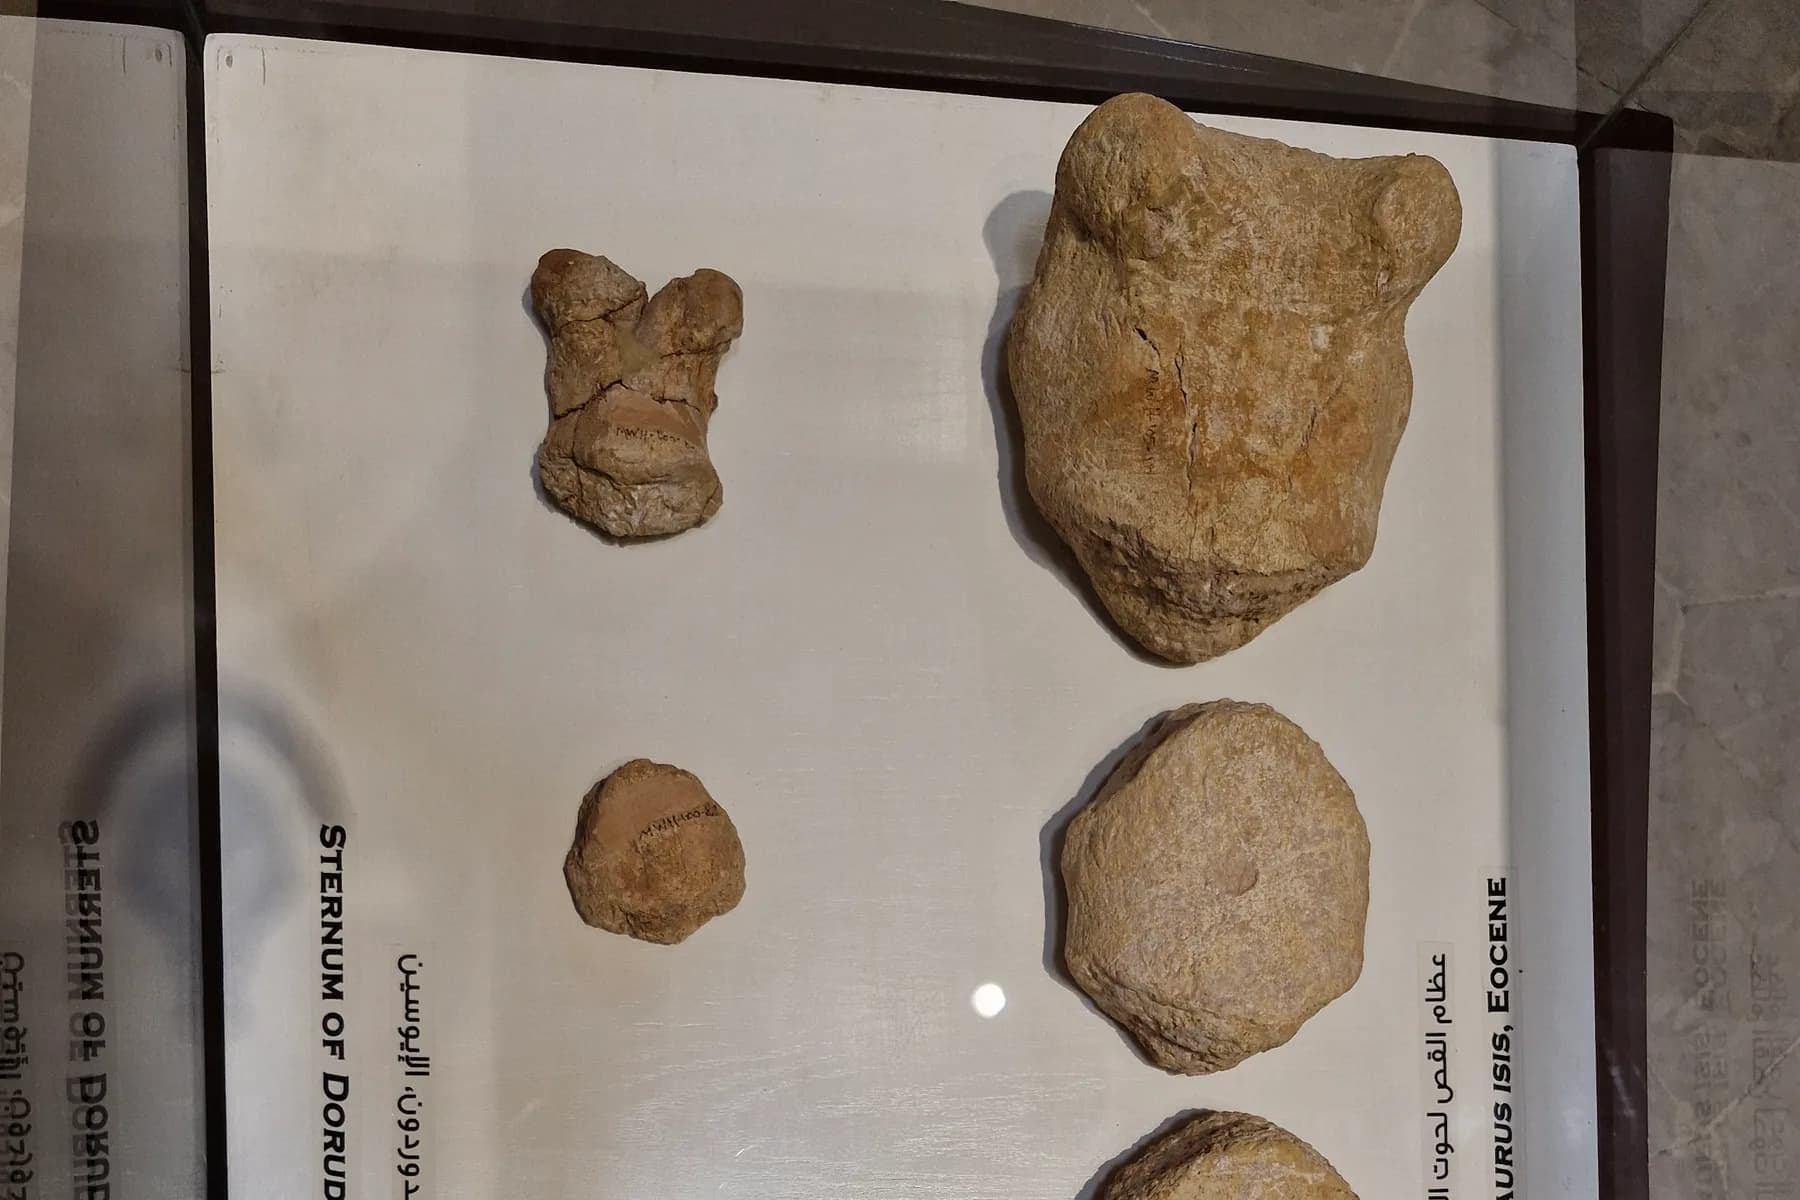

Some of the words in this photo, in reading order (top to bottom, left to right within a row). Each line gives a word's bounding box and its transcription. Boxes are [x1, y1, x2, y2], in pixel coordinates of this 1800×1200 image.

[319, 824, 346, 1000] STERNUM
[1487, 878, 1509, 1013] EOCENE
[398, 954, 430, 1076] الإيوسين
[1425, 954, 1452, 1023] عظام
[322, 1012, 345, 1060] OF
[1425, 1032, 1454, 1104] القص
[1492, 1025, 1513, 1093] ISIS,
[1426, 1112, 1454, 1180] لحوت
